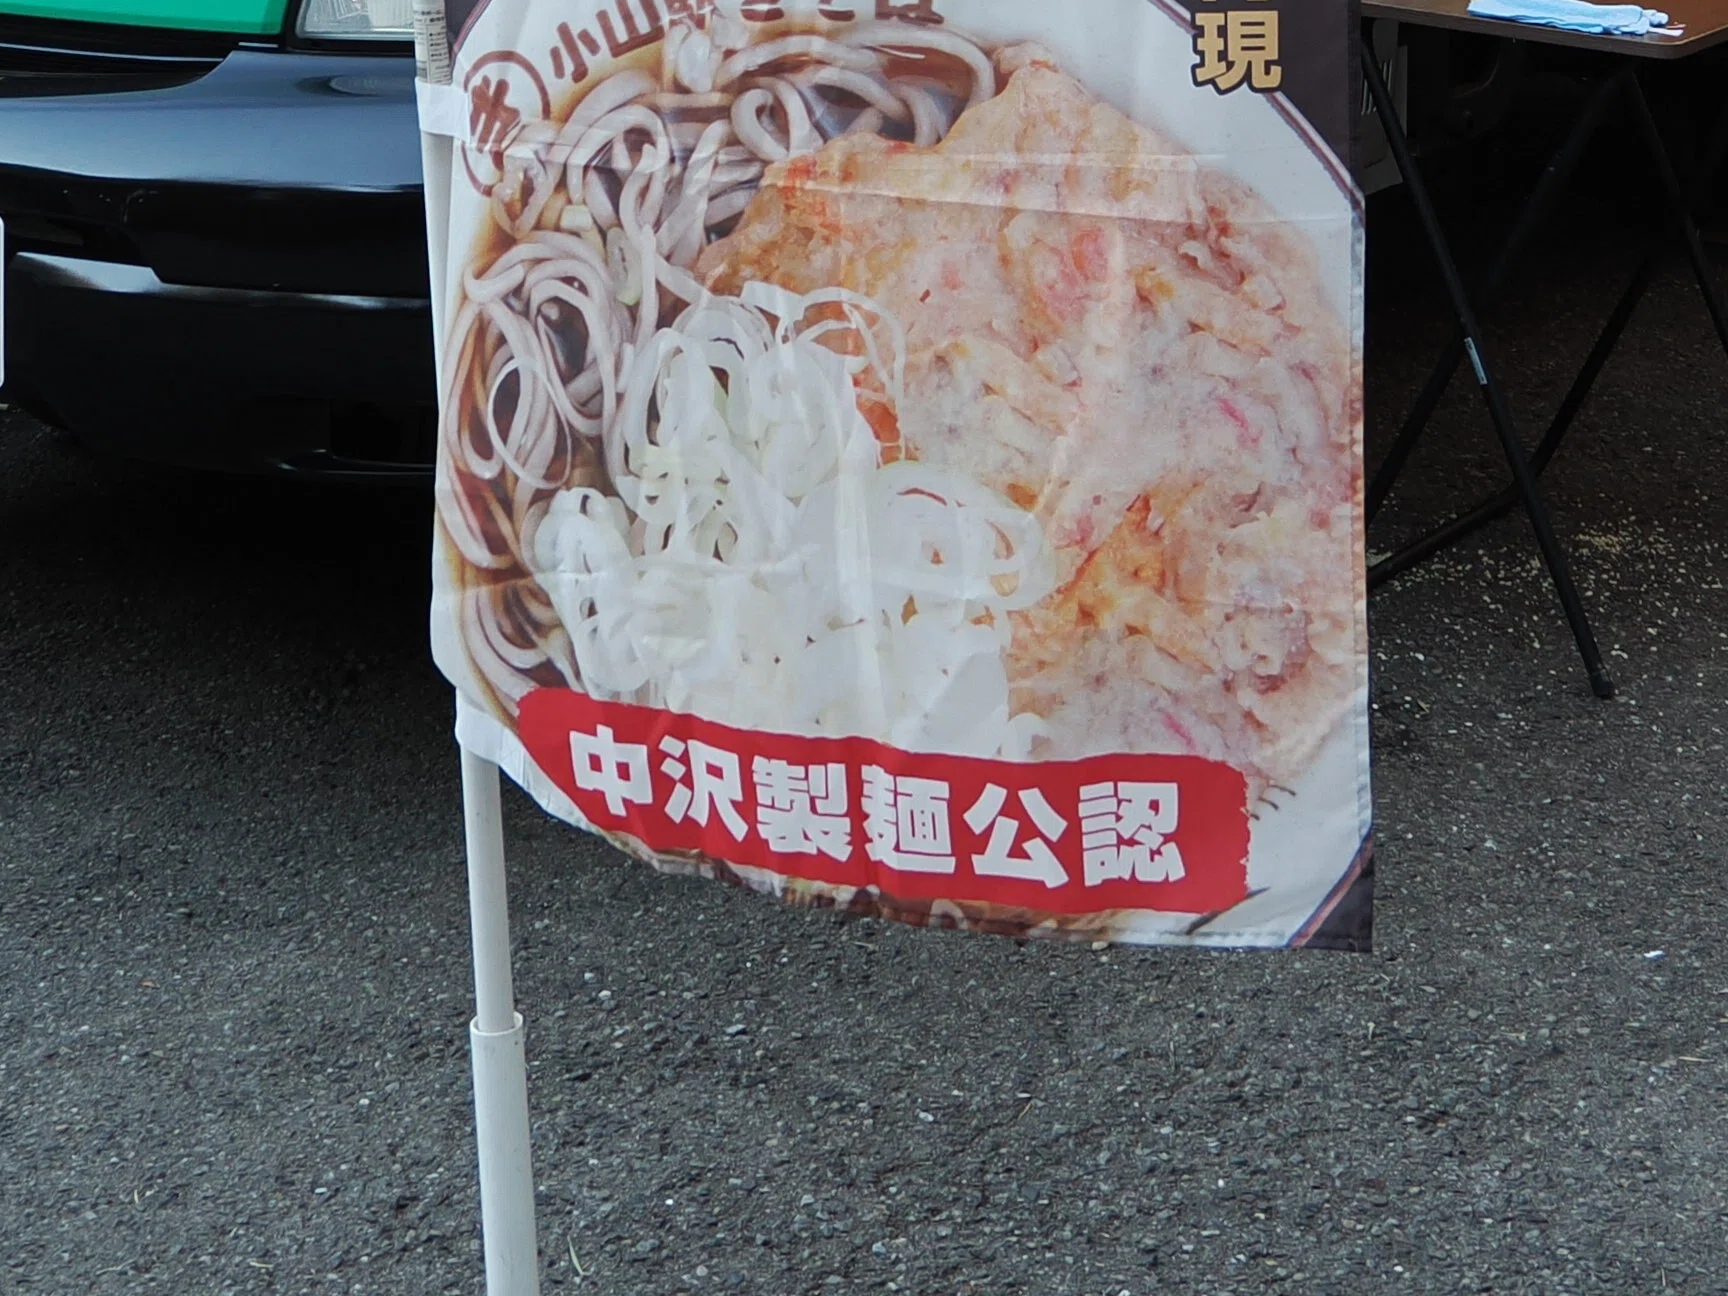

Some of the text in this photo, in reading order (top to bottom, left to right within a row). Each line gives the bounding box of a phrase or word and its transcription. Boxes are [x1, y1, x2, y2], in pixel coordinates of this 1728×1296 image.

[569, 724, 1187, 889] 中沢製麺公認
